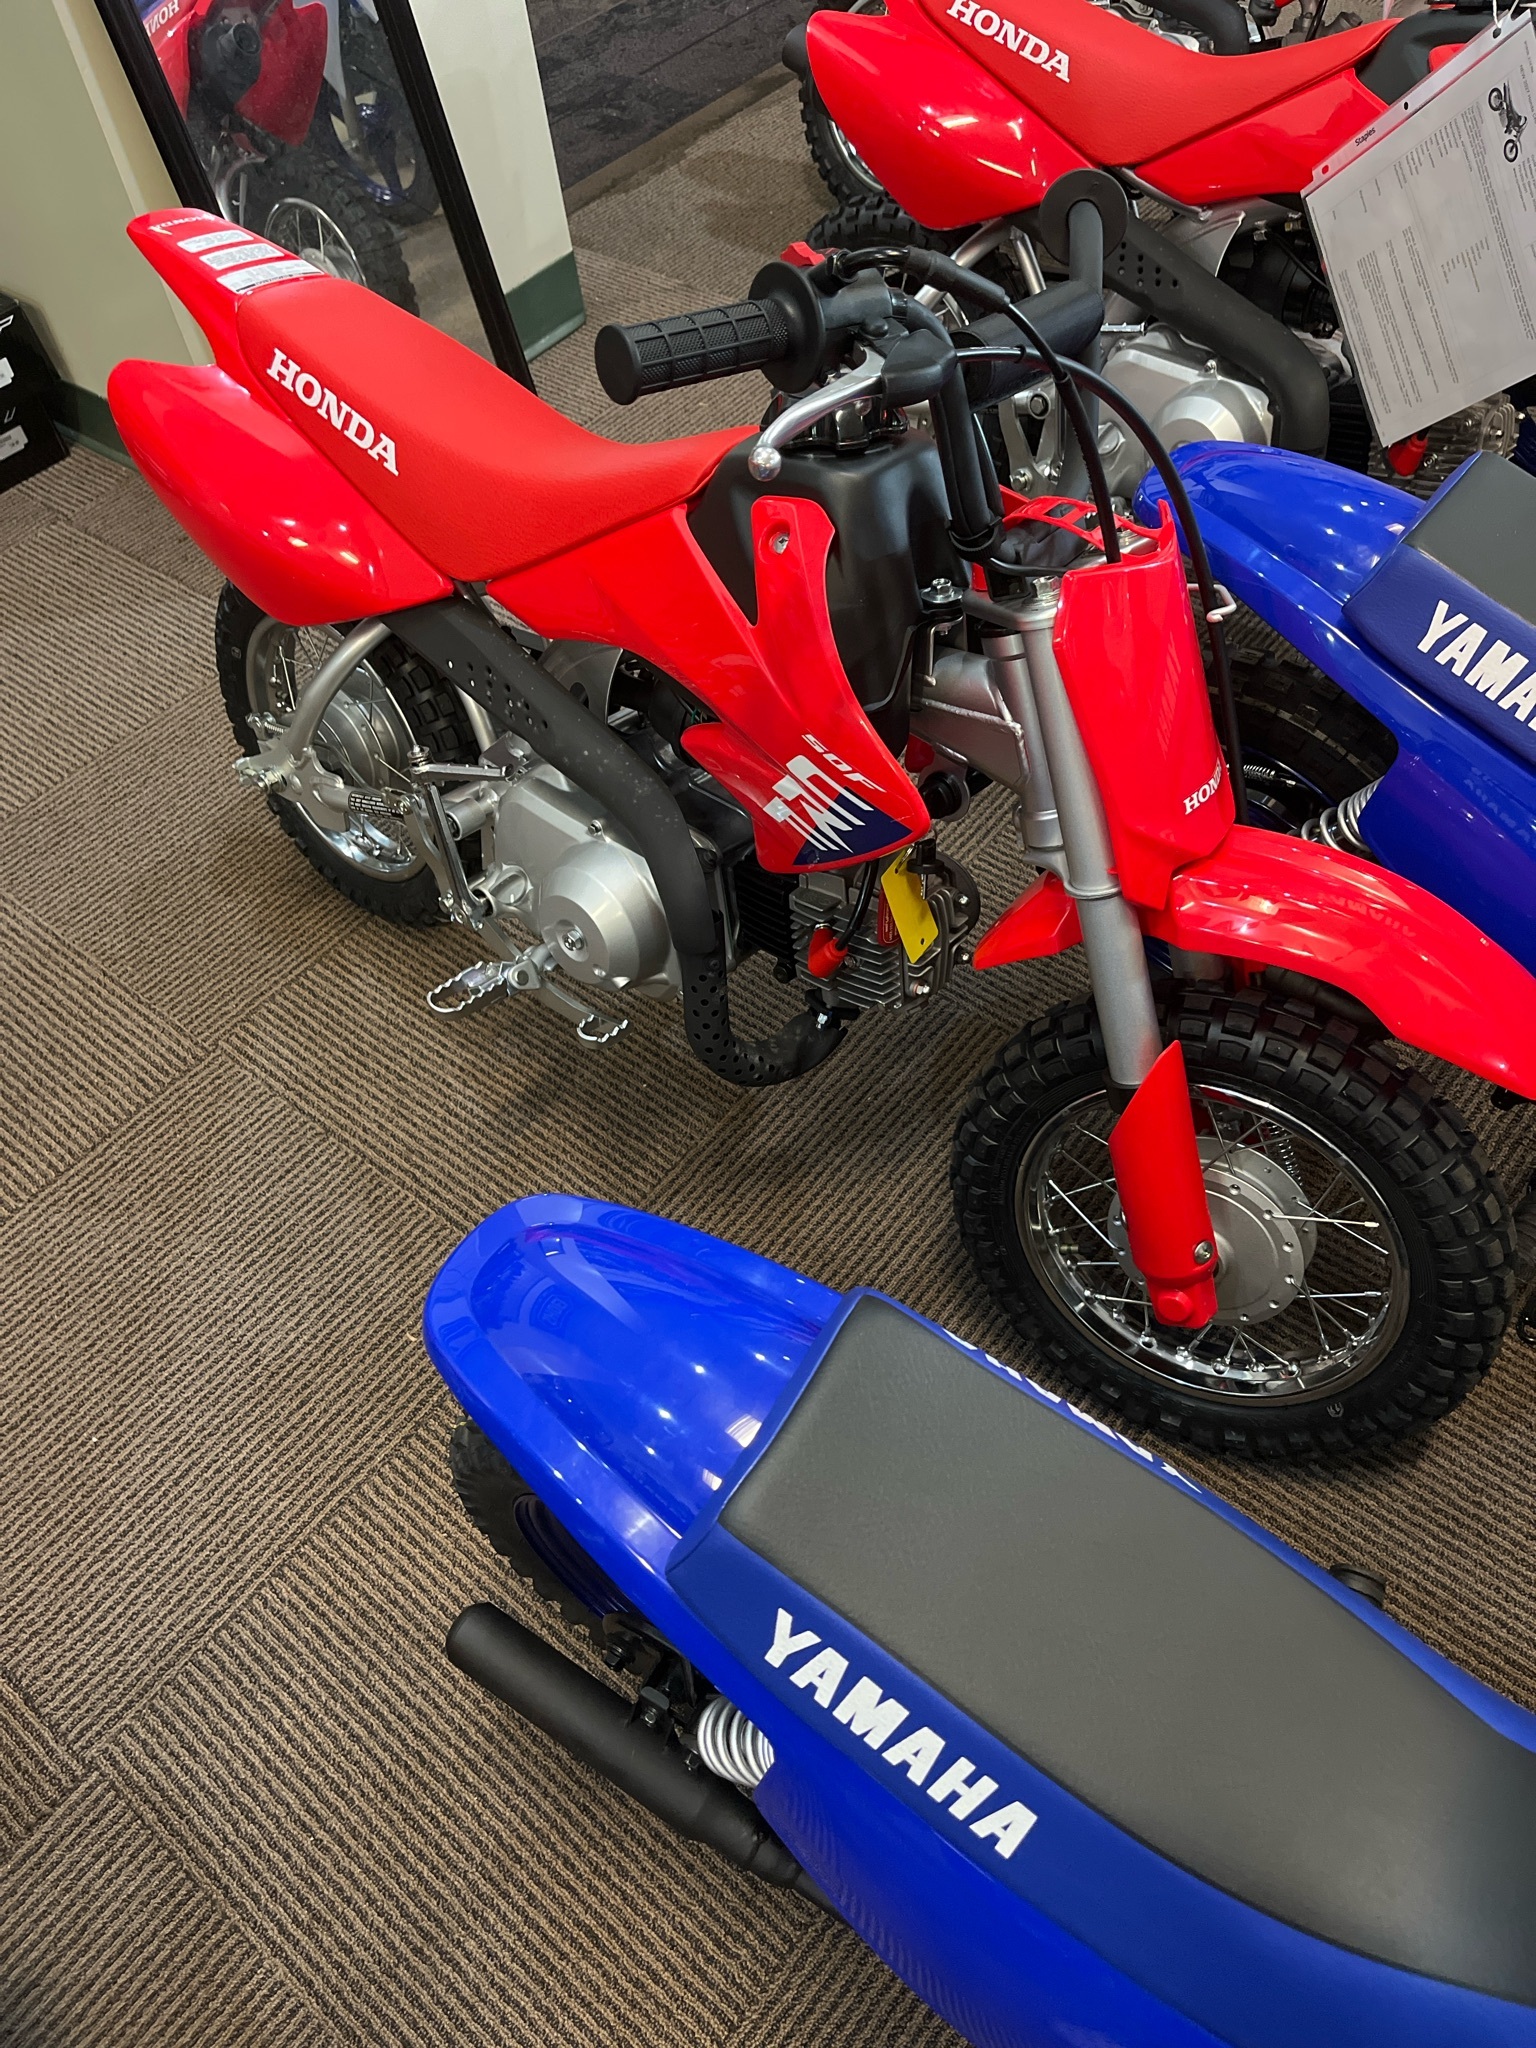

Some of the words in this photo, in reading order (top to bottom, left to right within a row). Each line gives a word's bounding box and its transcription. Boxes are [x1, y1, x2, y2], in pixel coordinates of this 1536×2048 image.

[946, 0, 1070, 83] HONDA
[1354, 127, 1376, 147] Staples
[266, 347, 399, 477] HONDA
[1417, 599, 1536, 732] YAMA
[762, 754, 875, 854] CRF
[801, 733, 887, 793] 50F
[764, 1607, 1038, 1859] YAMAHA
